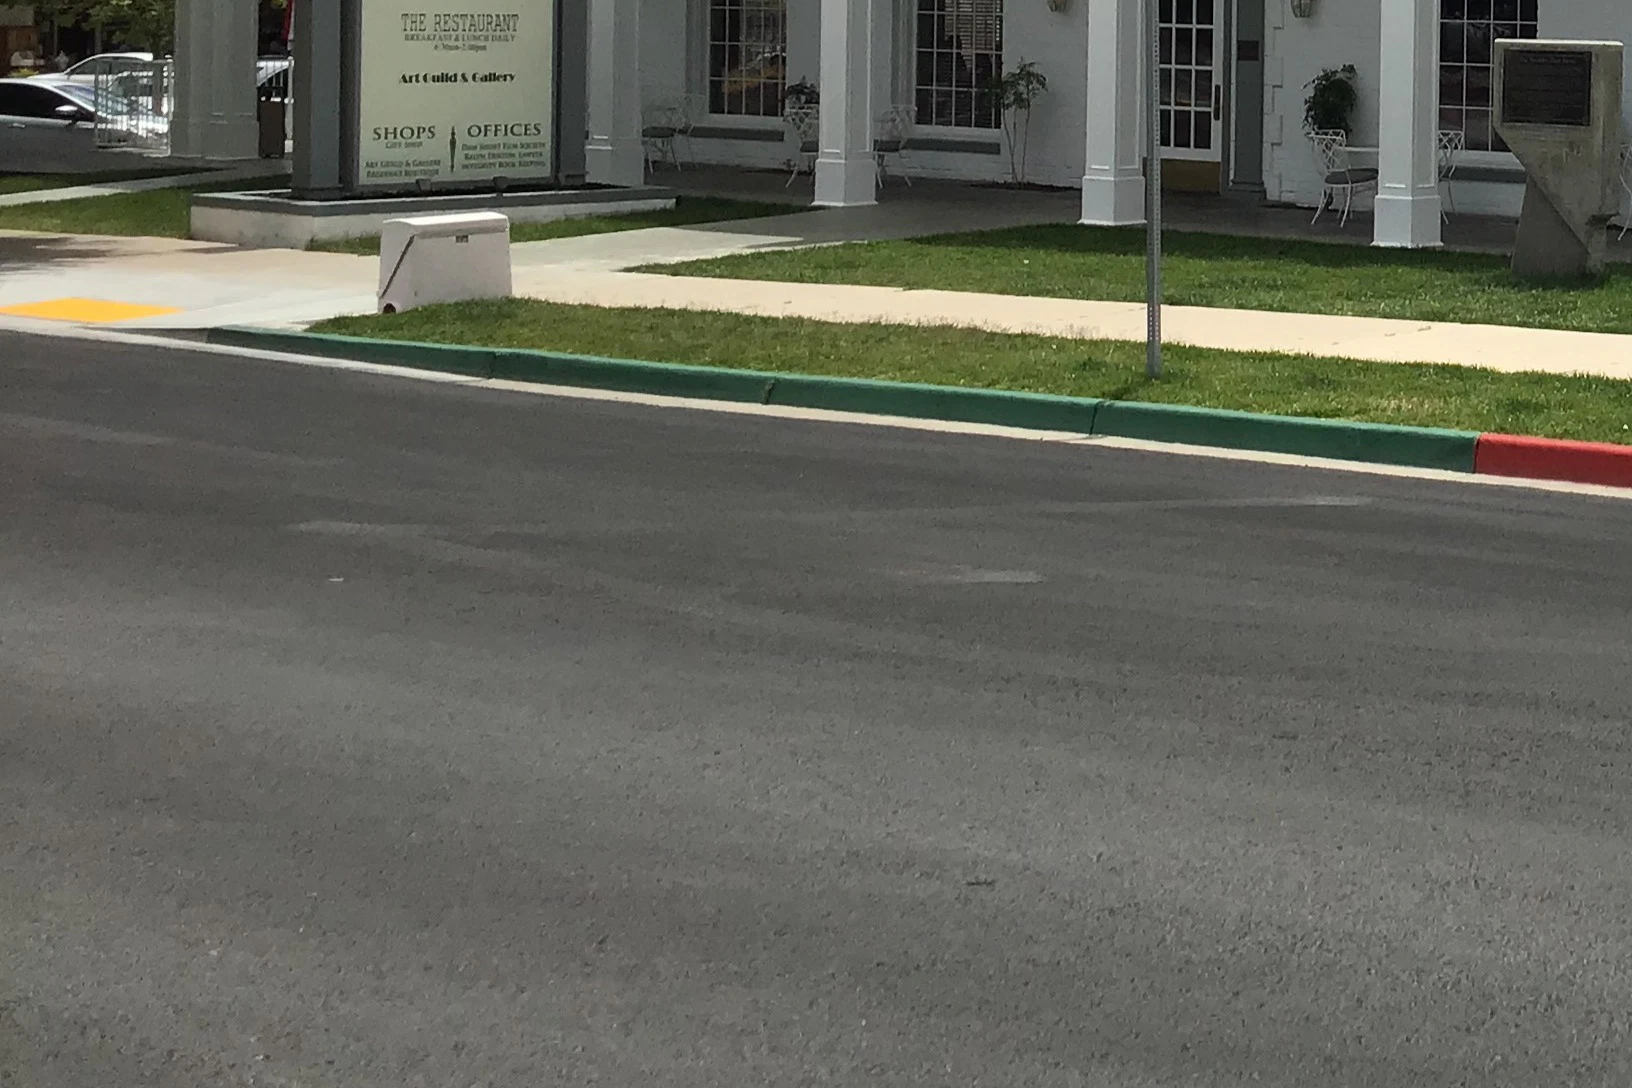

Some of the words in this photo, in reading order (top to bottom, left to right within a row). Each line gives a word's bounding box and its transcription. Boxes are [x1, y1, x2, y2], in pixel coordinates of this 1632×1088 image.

[401, 13, 427, 32] THE
[434, 13, 519, 33] RESTAURANT
[491, 34, 516, 42] DAILY
[399, 73, 420, 84] Art
[422, 72, 458, 83] Guild
[460, 72, 469, 83] &
[471, 72, 516, 84] Gallery
[373, 125, 436, 141] SHOPS
[467, 123, 542, 138] OFFICES
